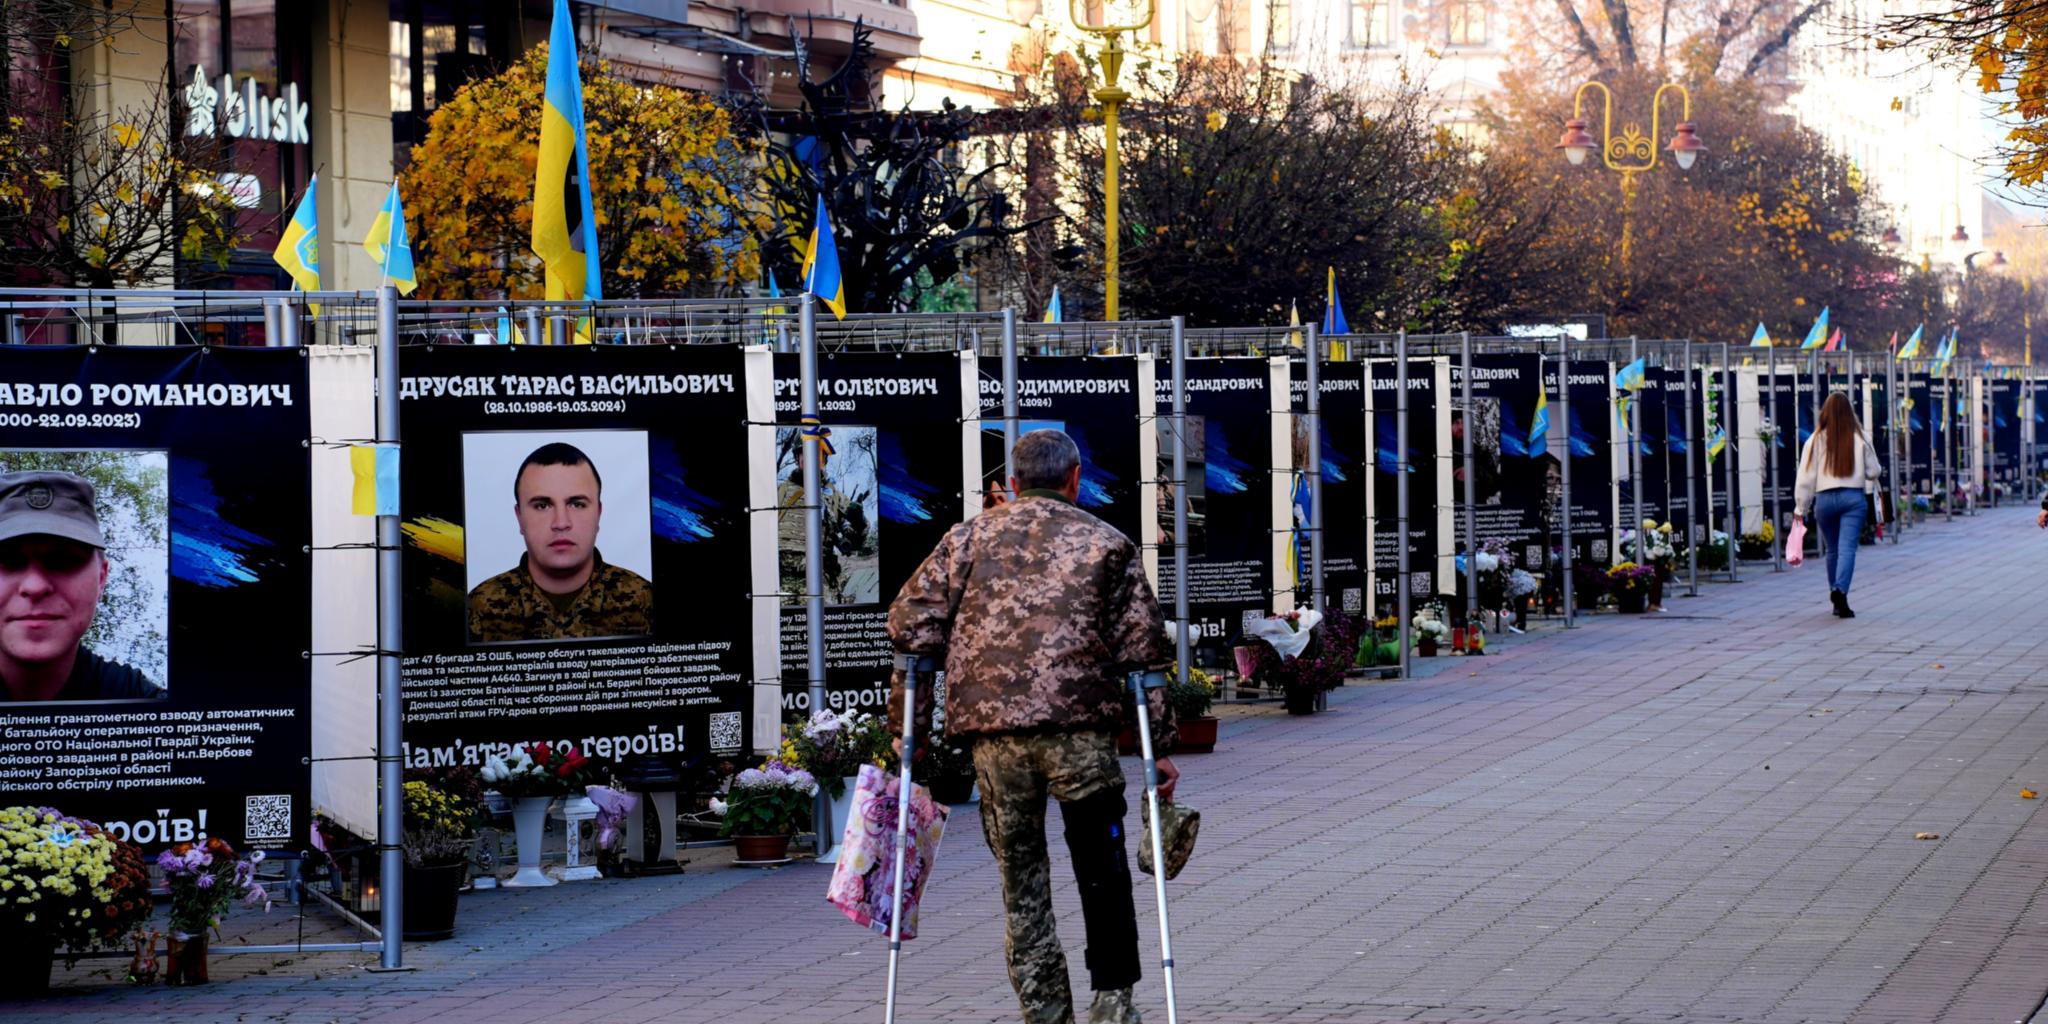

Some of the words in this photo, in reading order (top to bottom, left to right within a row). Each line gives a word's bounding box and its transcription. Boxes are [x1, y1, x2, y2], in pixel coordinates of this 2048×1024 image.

[500, 374, 576, 397] ТАРАС
[580, 374, 735, 396] ВАСИЛЬОВИЧ
[774, 378, 830, 396] РТМ
[834, 378, 938, 397] ОЛЕГОВИЧ
[979, 379, 1130, 396] ВООДИМИРОВИЧ
[1155, 378, 1263, 392] ОЛСАНДРОВИЧ
[90, 382, 293, 407] РОМАНОВИЧ
[484, 399, 626, 414] (28.10.1986-19.03.2024)
[794, 614, 807, 622] 128
[824, 622, 863, 631] иконуючи
[401, 657, 419, 666] дат
[422, 655, 433, 663] 47
[435, 654, 474, 664] бригада
[476, 653, 487, 661] 25
[488, 652, 514, 661] ОШБ,
[516, 651, 546, 661] номер
[548, 648, 585, 659] обслуги
[587, 646, 645, 656] такелажного
[647, 643, 696, 653] відділення
[698, 641, 731, 650] підвозу
[435, 667, 446, 675] та
[447, 665, 503, 674] мастильних
[505, 660, 554, 671] матеріалів
[557, 660, 588, 671] взводу
[590, 656, 655, 668] матеріального
[657, 653, 720, 663] забезпечення
[450, 676, 489, 685] частини
[525, 673, 562, 682] Загинув
[571, 669, 591, 679] ході
[592, 668, 641, 678] виконання
[643, 665, 681, 675] бойових
[683, 663, 721, 673] завдань,
[430, 688, 438, 697] із
[440, 686, 483, 696] захистом
[486, 684, 546, 695] Батьківщини
[556, 681, 587, 692] районі
[588, 681, 605, 690] н.п.
[606, 677, 643, 689] Бердичі
[645, 675, 707, 686] Покровського
[709, 673, 741, 684] району
[409, 699, 459, 711] Донецької
[461, 696, 496, 707] області
[498, 696, 513, 705] під
[515, 696, 531, 704] час
[532, 694, 583, 705] оборонних
[585, 691, 600, 701] дій
[602, 692, 619, 701] при
[621, 687, 663, 699] зіткненні
[671, 686, 711, 696] ворогом.
[54, 712, 157, 726] гранатометного
[160, 711, 204, 722] взводу
[207, 709, 295, 719] автоматичних
[407, 710, 457, 723] результаті
[459, 710, 486, 719] атаки
[488, 706, 537, 717] FPV-дрона
[539, 705, 578, 715] отримав
[580, 702, 629, 713] поранення
[631, 698, 677, 710] несумісне
[686, 696, 721, 706] життям.
[5, 726, 81, 739] батальйону
[84, 725, 174, 738] оперативного
[177, 722, 263, 735] призначення,
[0, 743, 31, 752] ного
[34, 740, 63, 751] ОТО
[66, 737, 152, 751] Національної
[155, 735, 199, 748] Гвардії
[201, 734, 255, 747] України.
[581, 725, 684, 763] героїв!
[56, 753, 117, 764] завдання
[120, 753, 128, 761] в
[131, 749, 174, 763] районі
[177, 747, 253, 760] н.п.Вербове
[45, 764, 121, 778] Запорізької
[124, 762, 171, 775] області
[57, 778, 113, 791] обстрілу
[116, 777, 205, 790] противником.
[93, 809, 207, 844] роїв!
